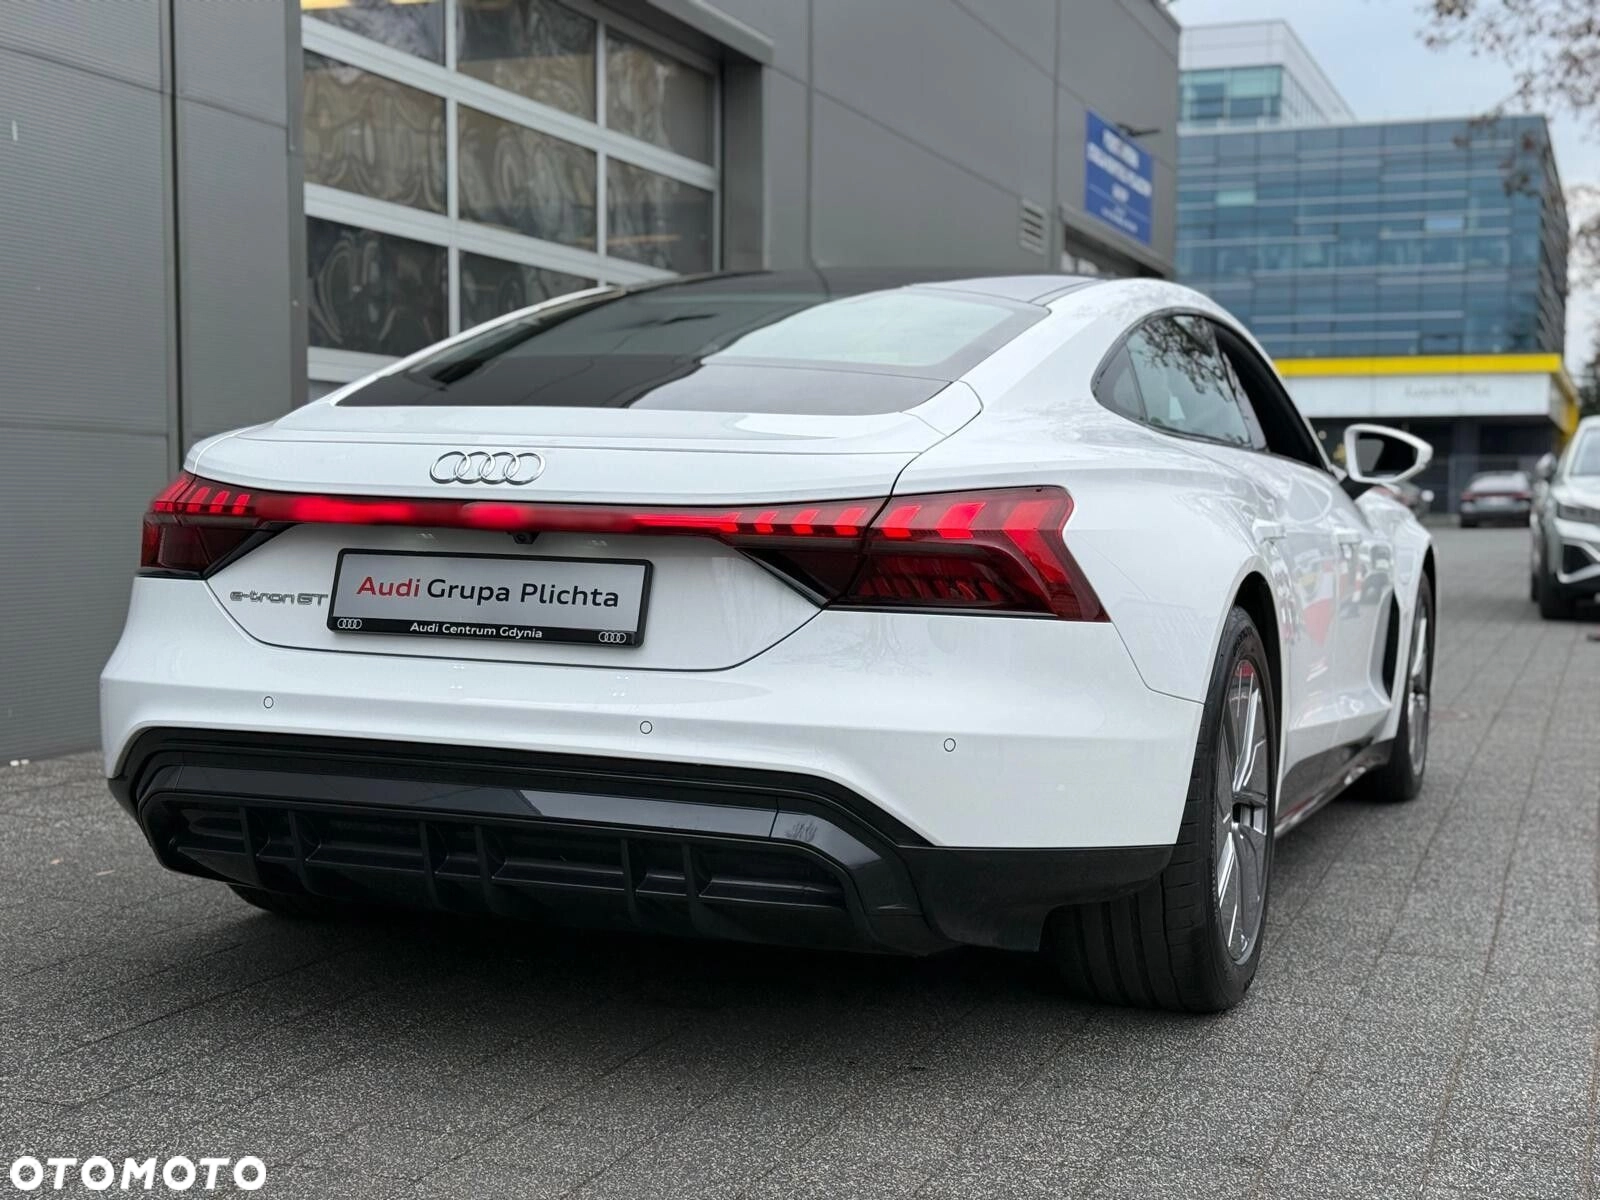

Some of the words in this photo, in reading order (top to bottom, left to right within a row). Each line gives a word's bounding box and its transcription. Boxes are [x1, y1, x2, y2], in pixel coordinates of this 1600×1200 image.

[356, 576, 420, 597] Audi
[427, 578, 510, 606] Grupa
[520, 583, 619, 607] Plichta
[410, 622, 439, 633] Audi
[442, 624, 496, 635] Centrum
[499, 627, 543, 639] Gdynia
